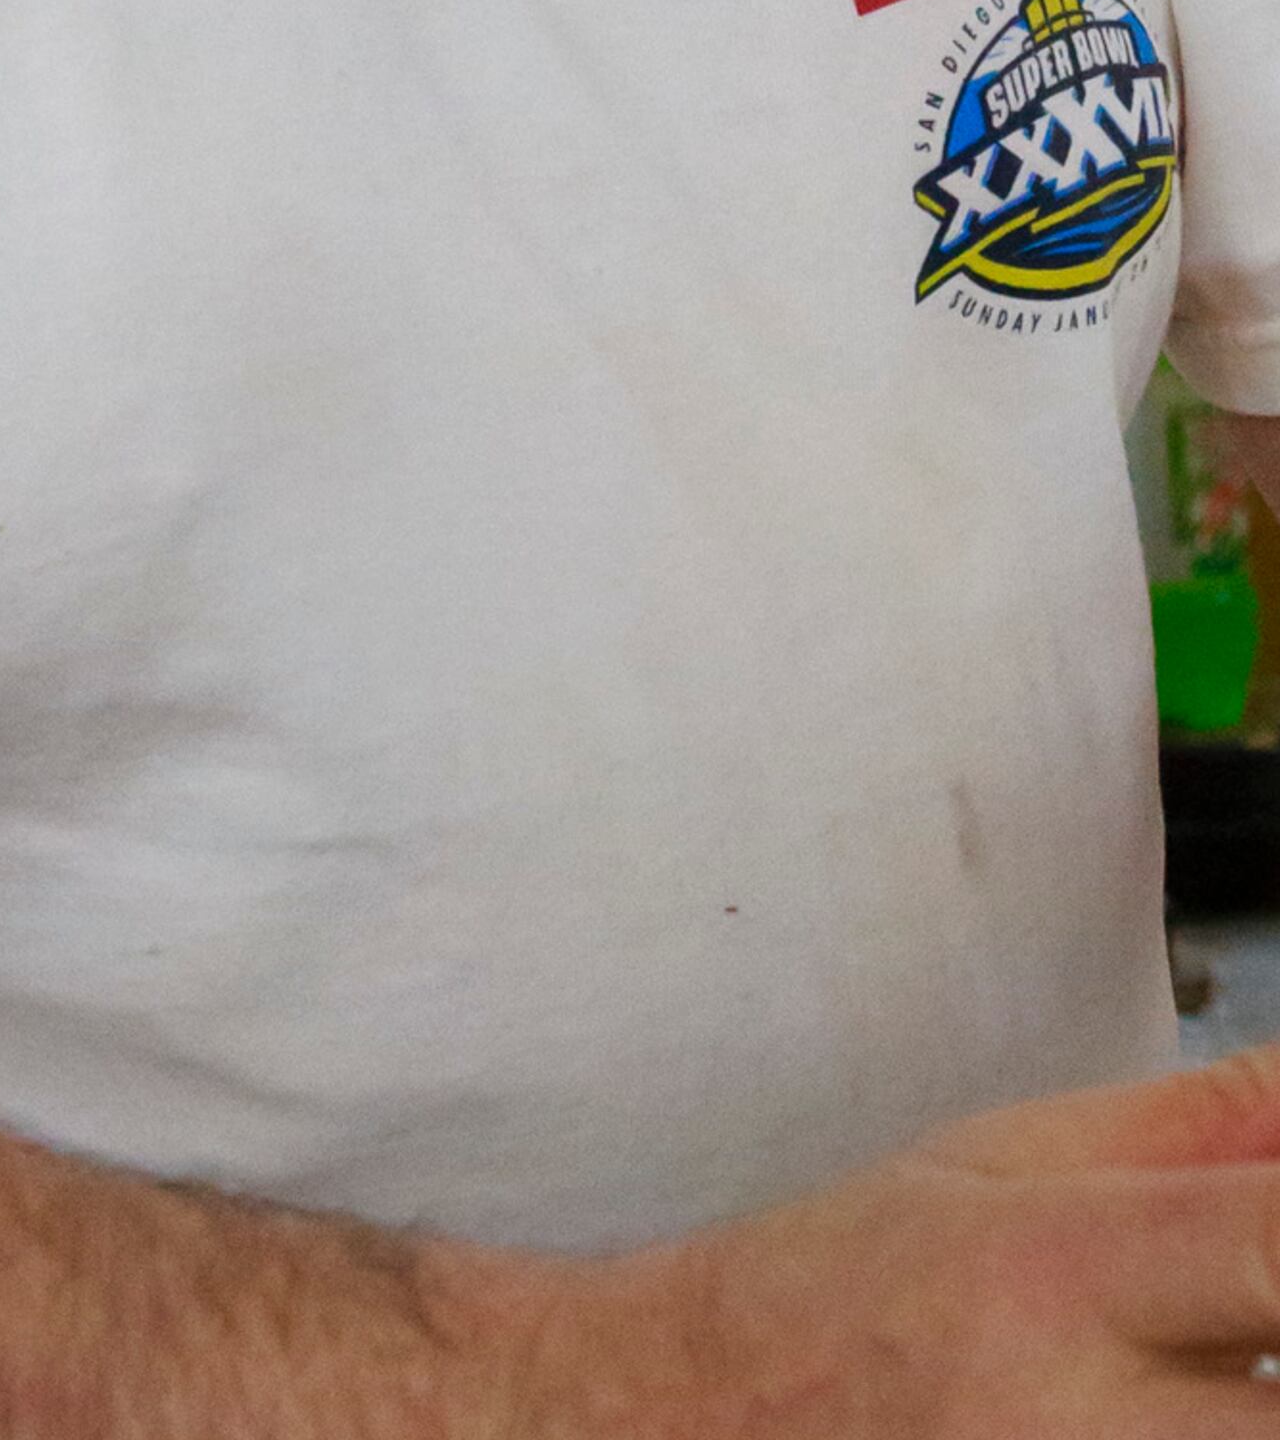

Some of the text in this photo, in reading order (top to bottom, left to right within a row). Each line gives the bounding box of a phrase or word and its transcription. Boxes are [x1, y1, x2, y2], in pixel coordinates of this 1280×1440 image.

[984, 26, 1140, 130] SUPER BOWL
[914, 91, 945, 153] SAN
[948, 289, 1042, 333] SUNDAY
